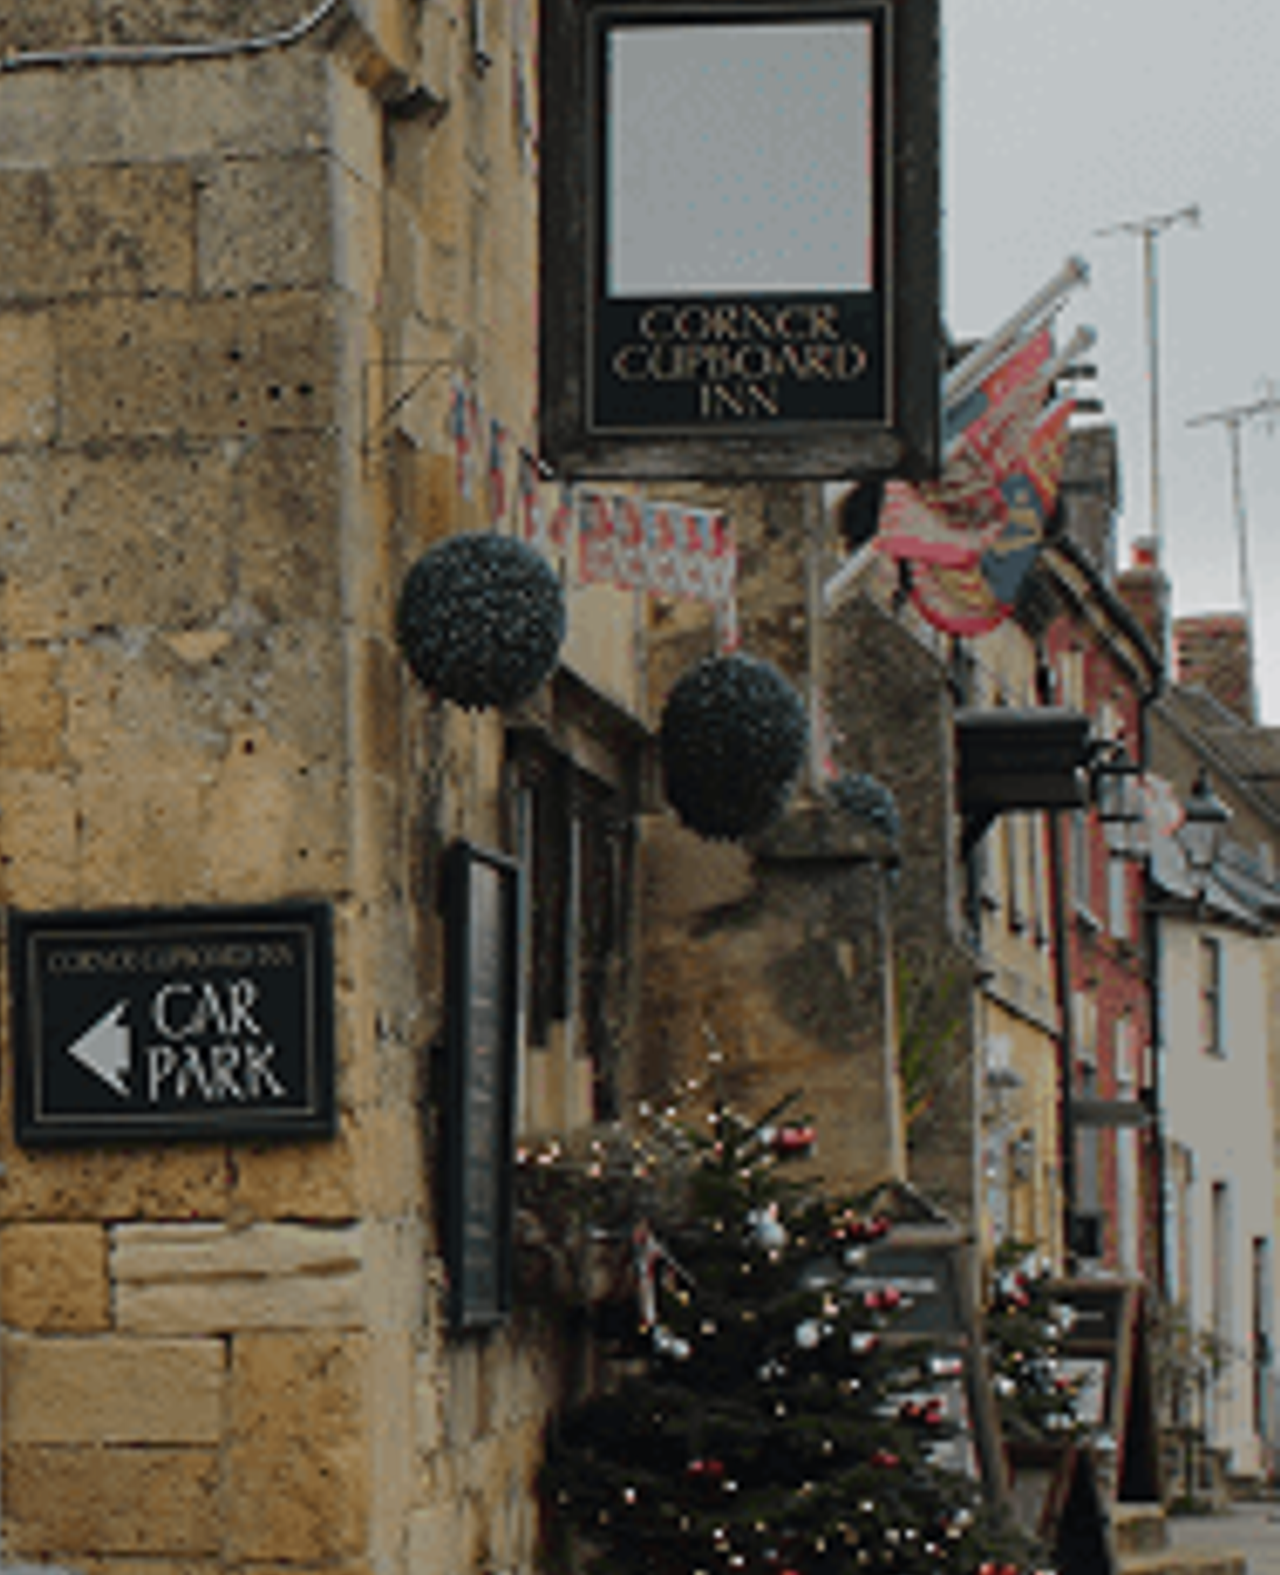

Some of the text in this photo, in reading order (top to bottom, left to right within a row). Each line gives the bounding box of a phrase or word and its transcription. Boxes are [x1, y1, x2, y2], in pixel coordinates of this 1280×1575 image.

[641, 303, 839, 340] CORNER
[612, 344, 868, 382] CUPBOARD
[699, 382, 780, 416] INN
[153, 979, 262, 1041] CAR
[144, 1042, 286, 1102] PARK
